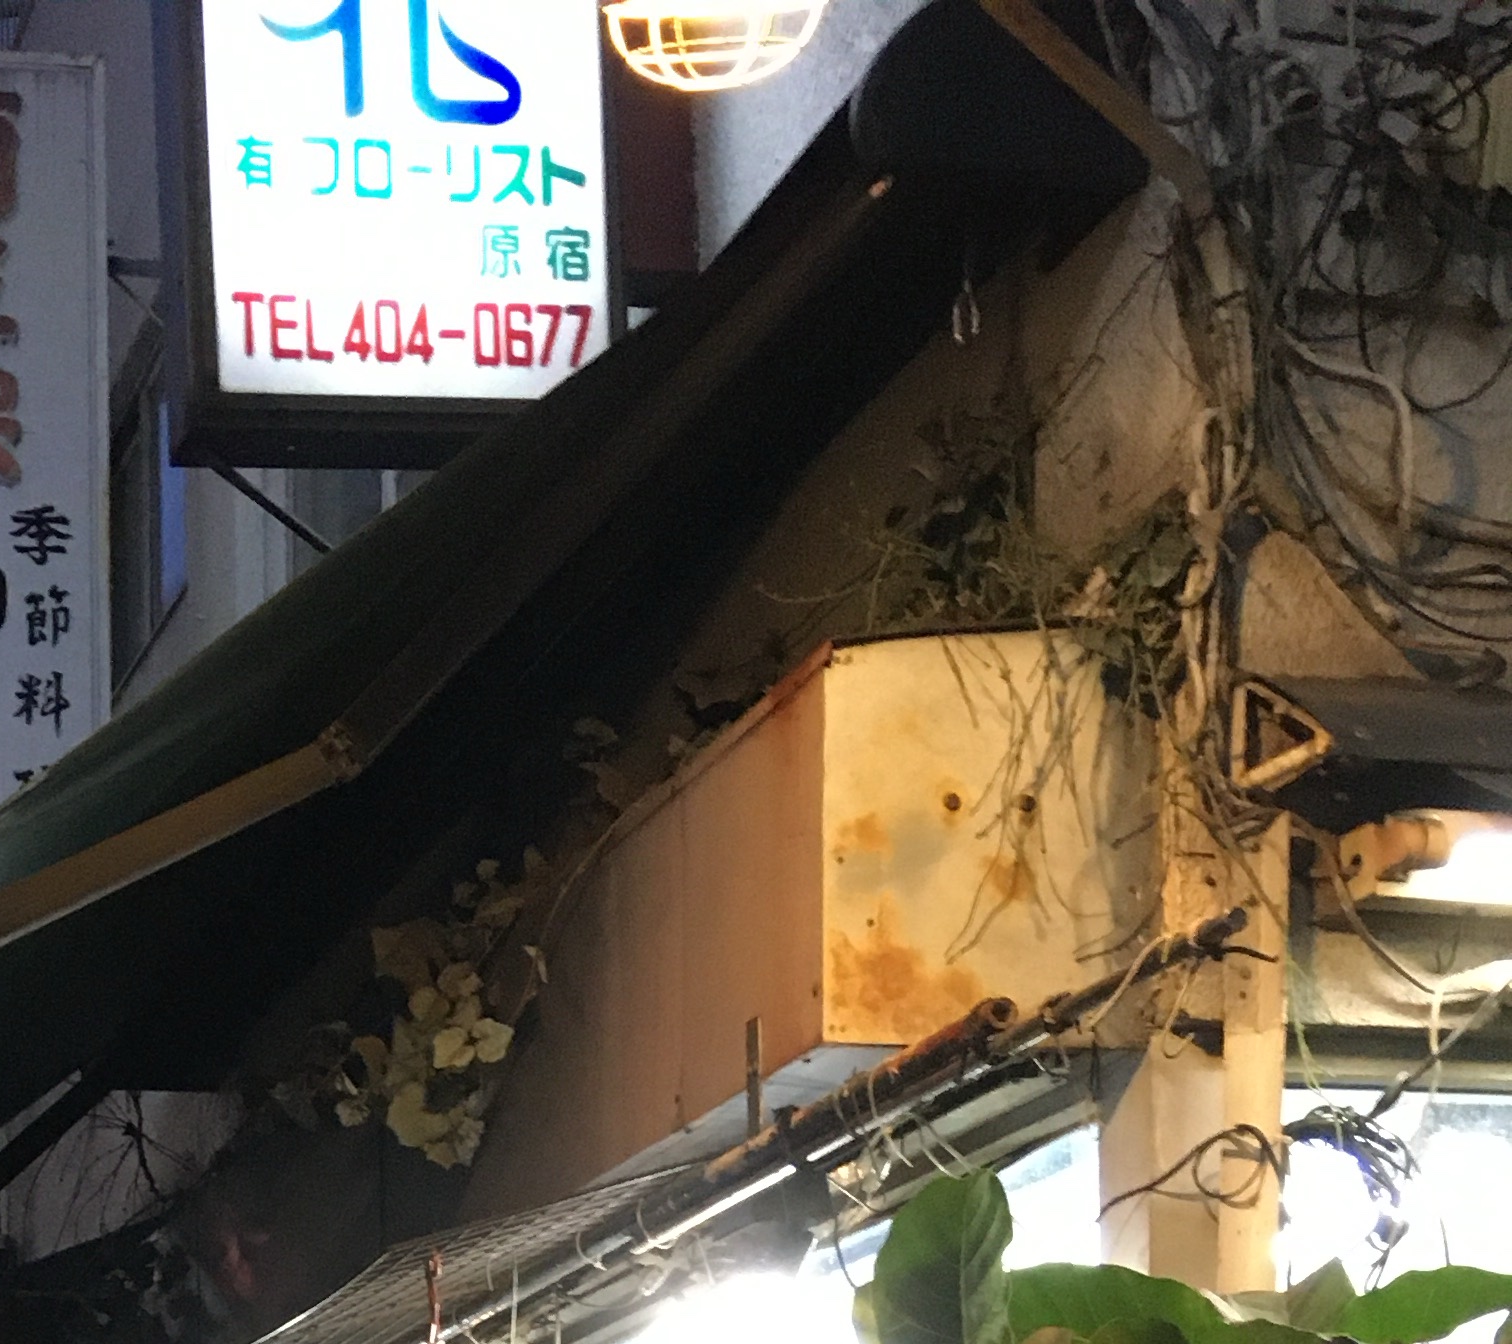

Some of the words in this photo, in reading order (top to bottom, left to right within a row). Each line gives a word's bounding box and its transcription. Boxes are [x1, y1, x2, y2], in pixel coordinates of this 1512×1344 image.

[302, 136, 587, 207] フローリスト
[480, 224, 592, 282] 原宿
[231, 291, 335, 363] TEL
[343, 299, 594, 369] 404-0677
[8, 504, 74, 785] 季節料
